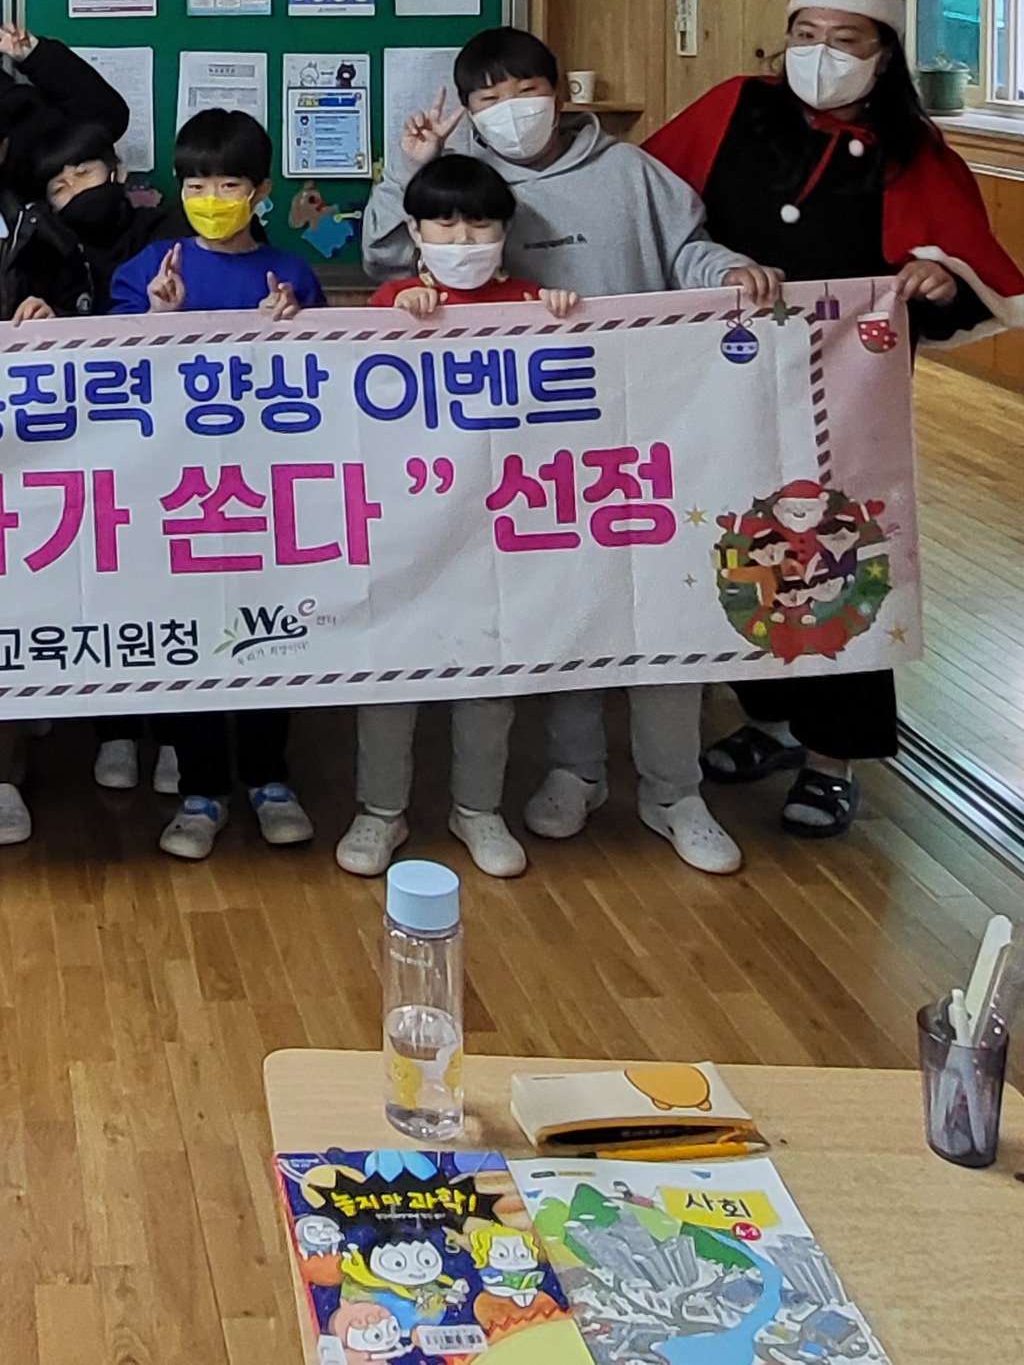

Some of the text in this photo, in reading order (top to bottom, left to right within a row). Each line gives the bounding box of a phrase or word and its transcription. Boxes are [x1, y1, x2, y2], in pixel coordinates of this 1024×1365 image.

[177, 352, 330, 436] 향상
[352, 346, 597, 432] 이벤트
[485, 443, 676, 553] 선정
[684, 1193, 752, 1219] 사회
